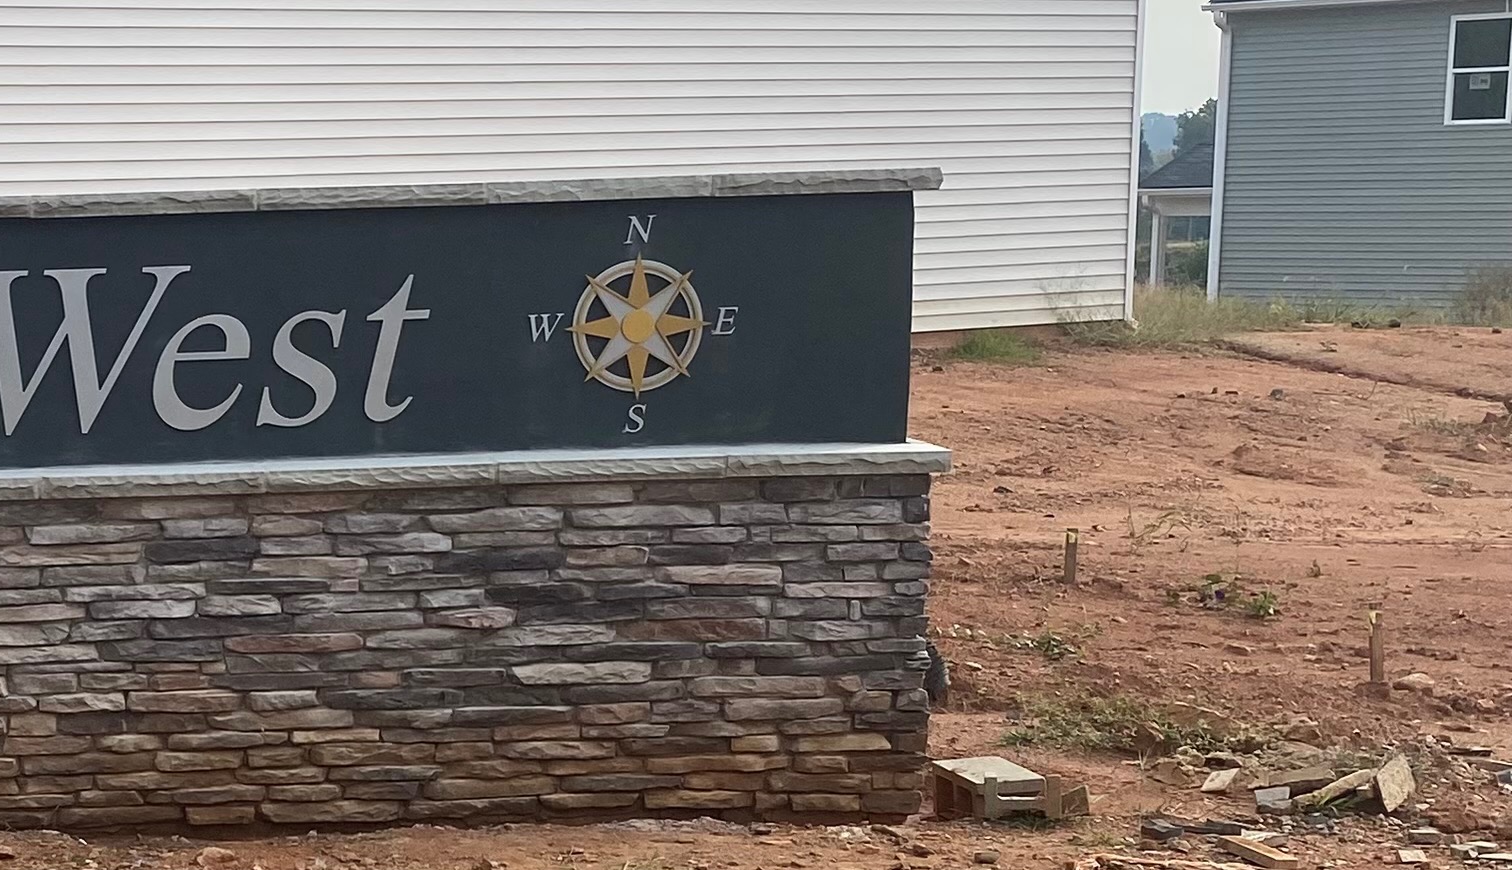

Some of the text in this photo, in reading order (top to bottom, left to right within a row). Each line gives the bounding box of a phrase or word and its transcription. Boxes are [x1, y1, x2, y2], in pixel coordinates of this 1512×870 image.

[623, 214, 657, 244] N
[528, 313, 564, 343] W
[711, 306, 739, 336] E
[622, 404, 647, 433] S
